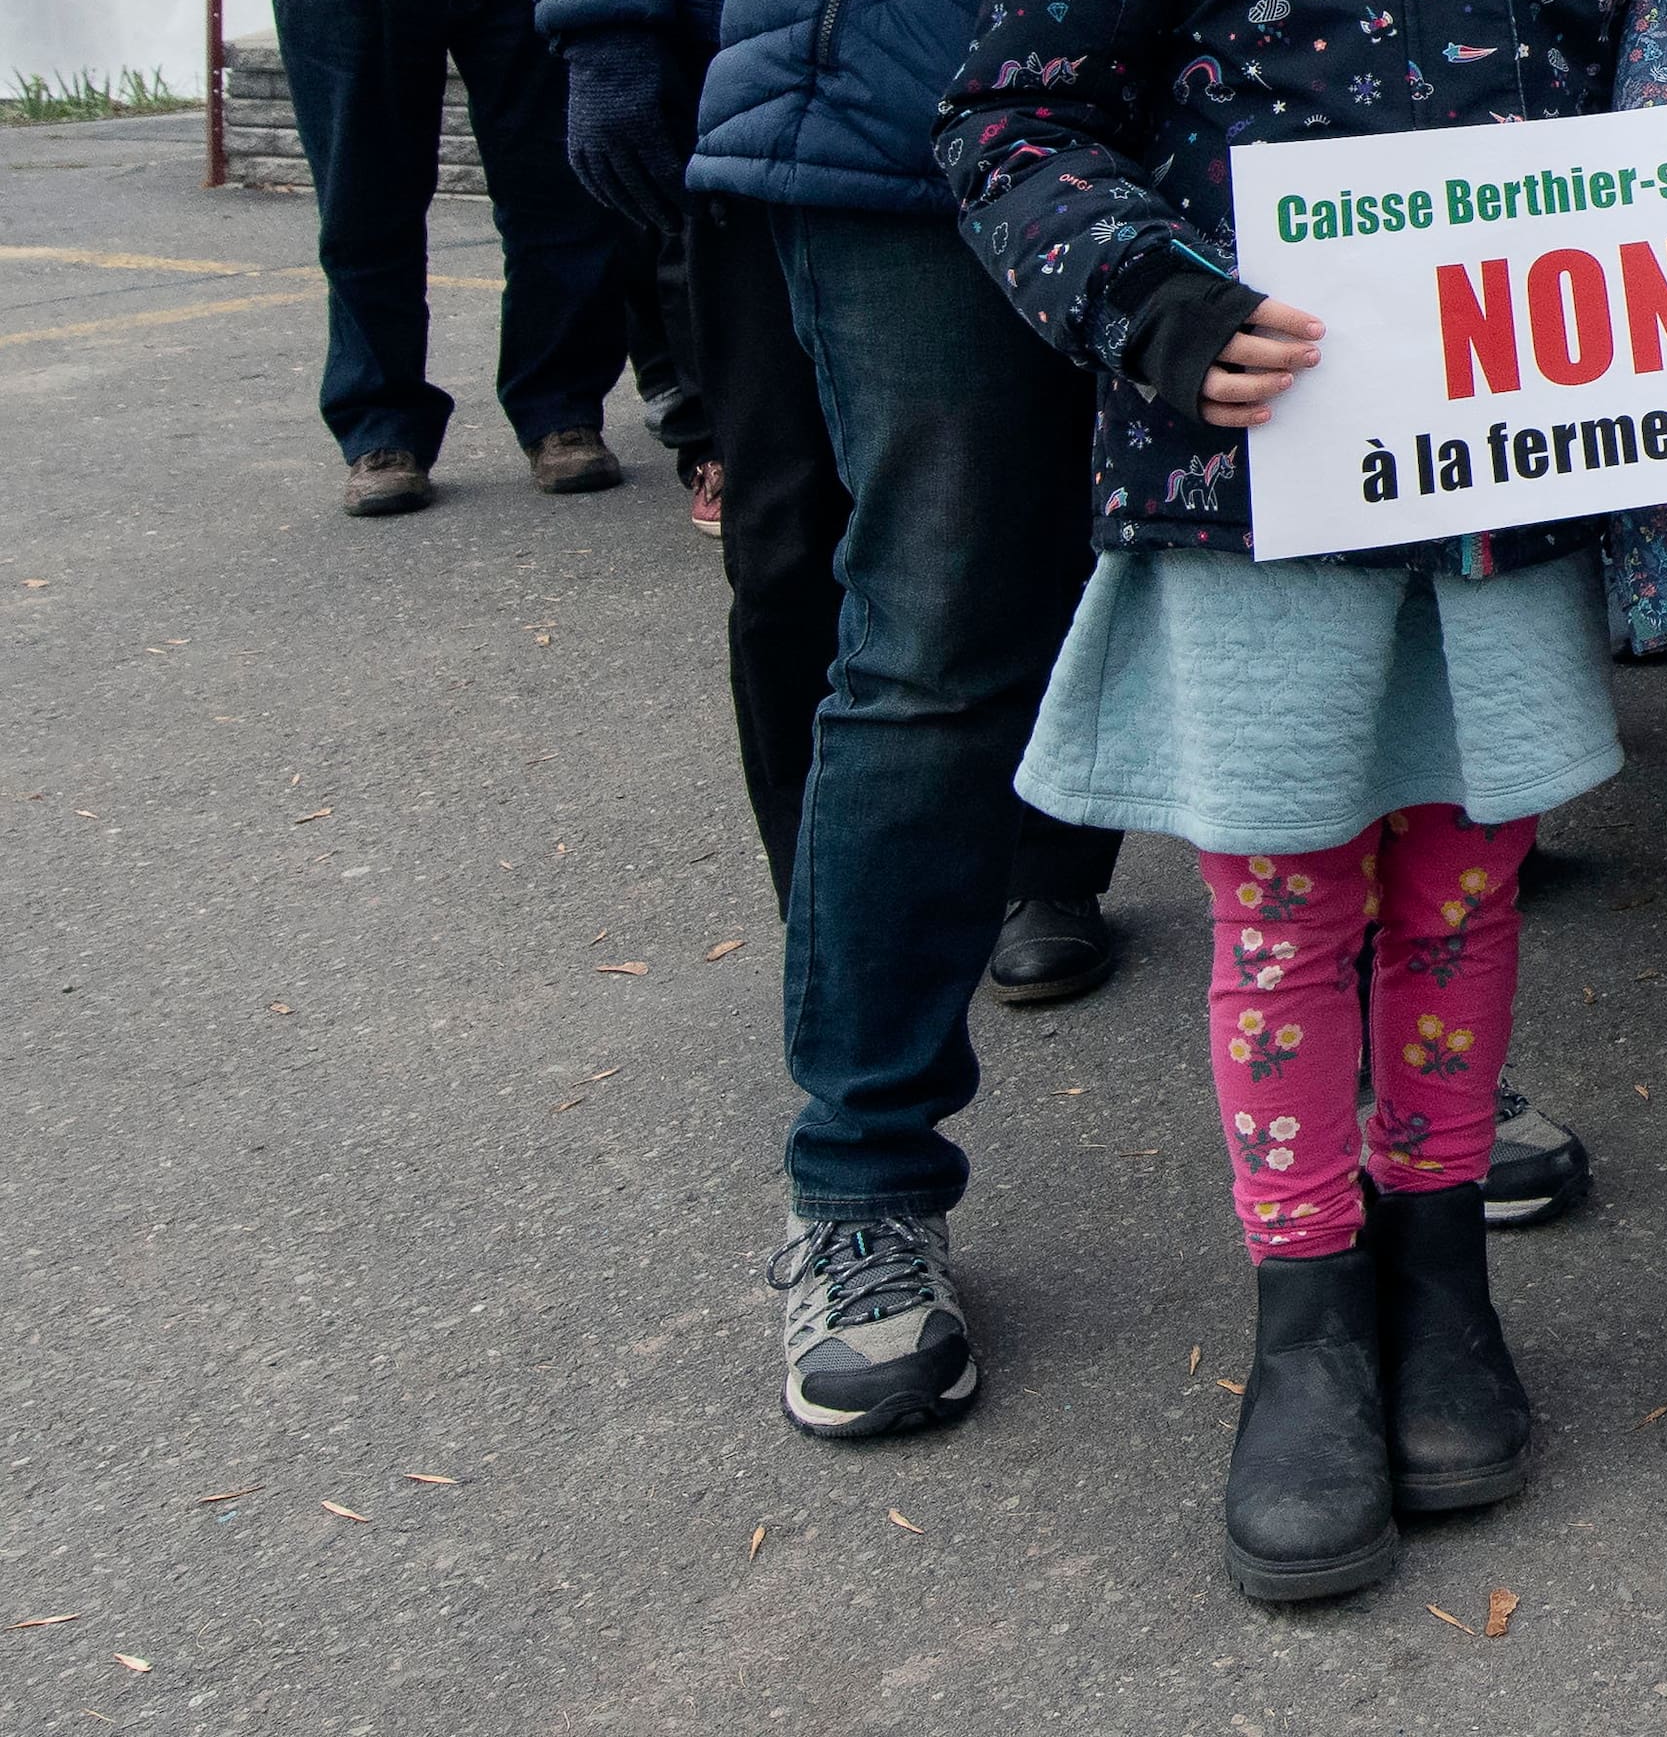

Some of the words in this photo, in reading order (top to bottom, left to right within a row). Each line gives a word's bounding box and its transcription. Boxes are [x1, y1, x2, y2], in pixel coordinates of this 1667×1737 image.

[1276, 191, 1434, 244] Caisse
[1361, 438, 1399, 503] à
[1415, 432, 1473, 495] la
